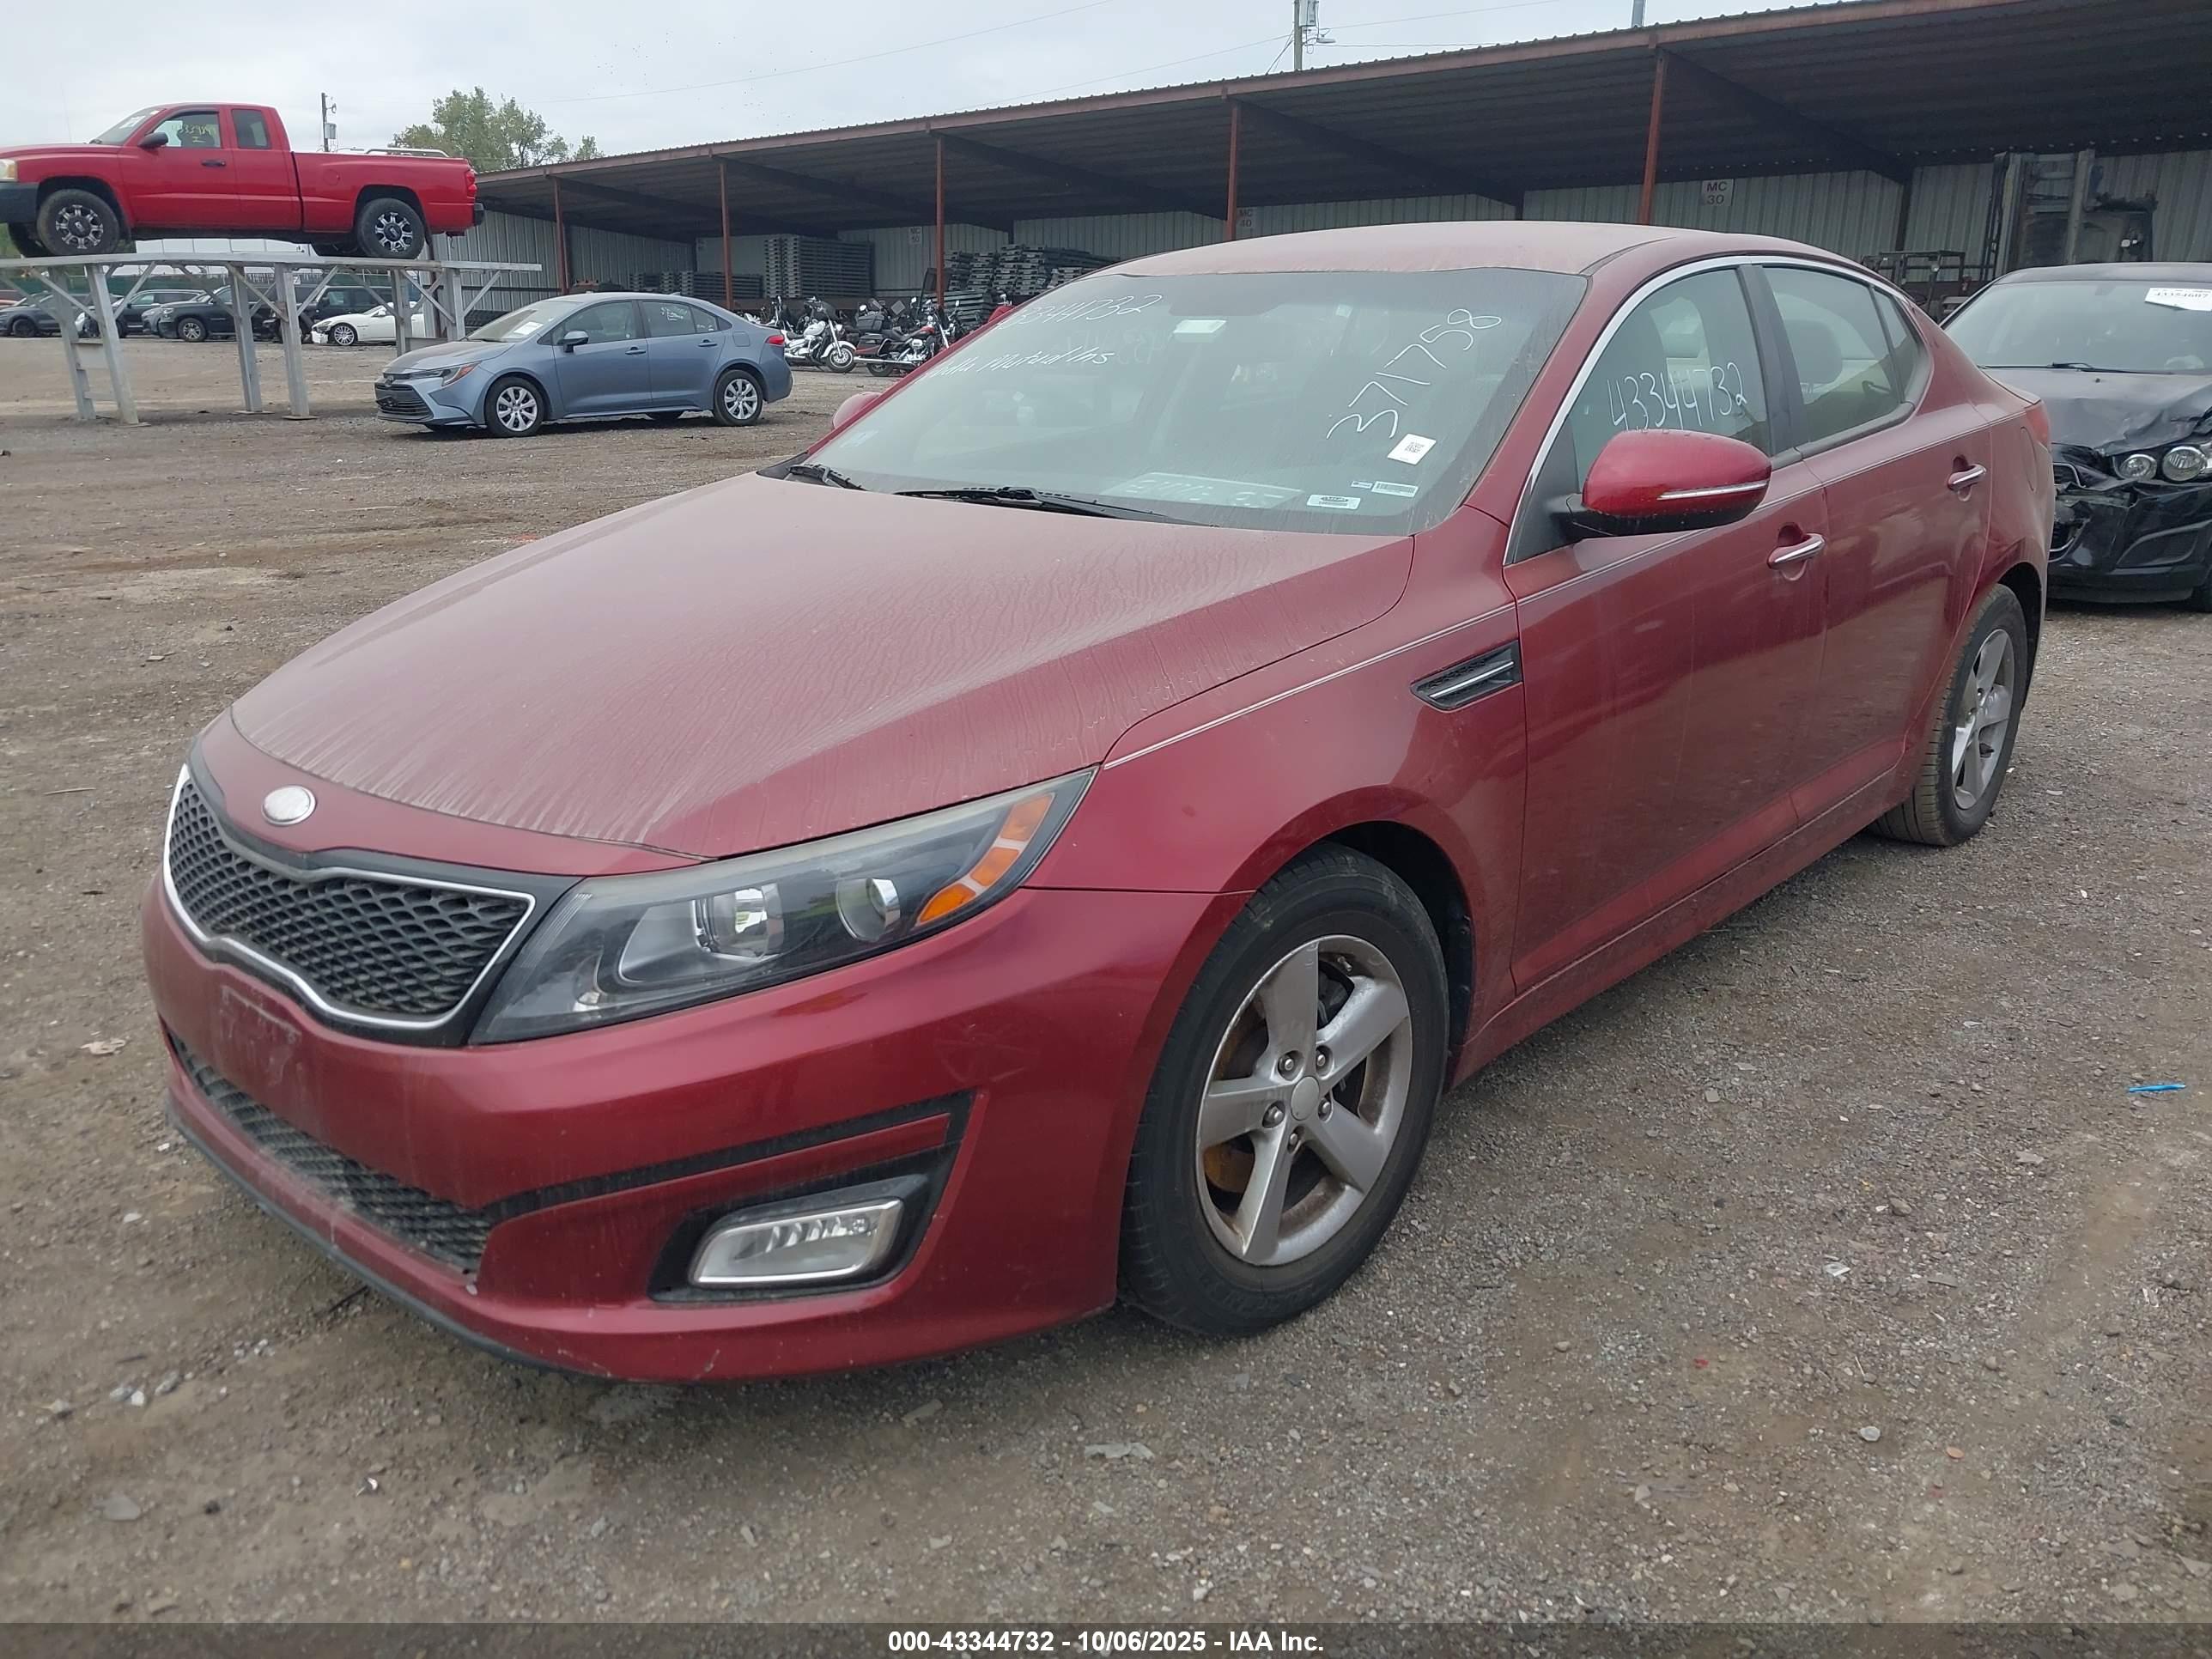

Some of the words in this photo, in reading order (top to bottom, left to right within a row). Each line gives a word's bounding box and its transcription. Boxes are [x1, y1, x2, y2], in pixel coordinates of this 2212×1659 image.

[1706, 181, 1728, 192] MC
[1707, 194, 1724, 205] 30
[1326, 308, 1502, 439] 371758
[1607, 362, 1748, 431] 43344732
